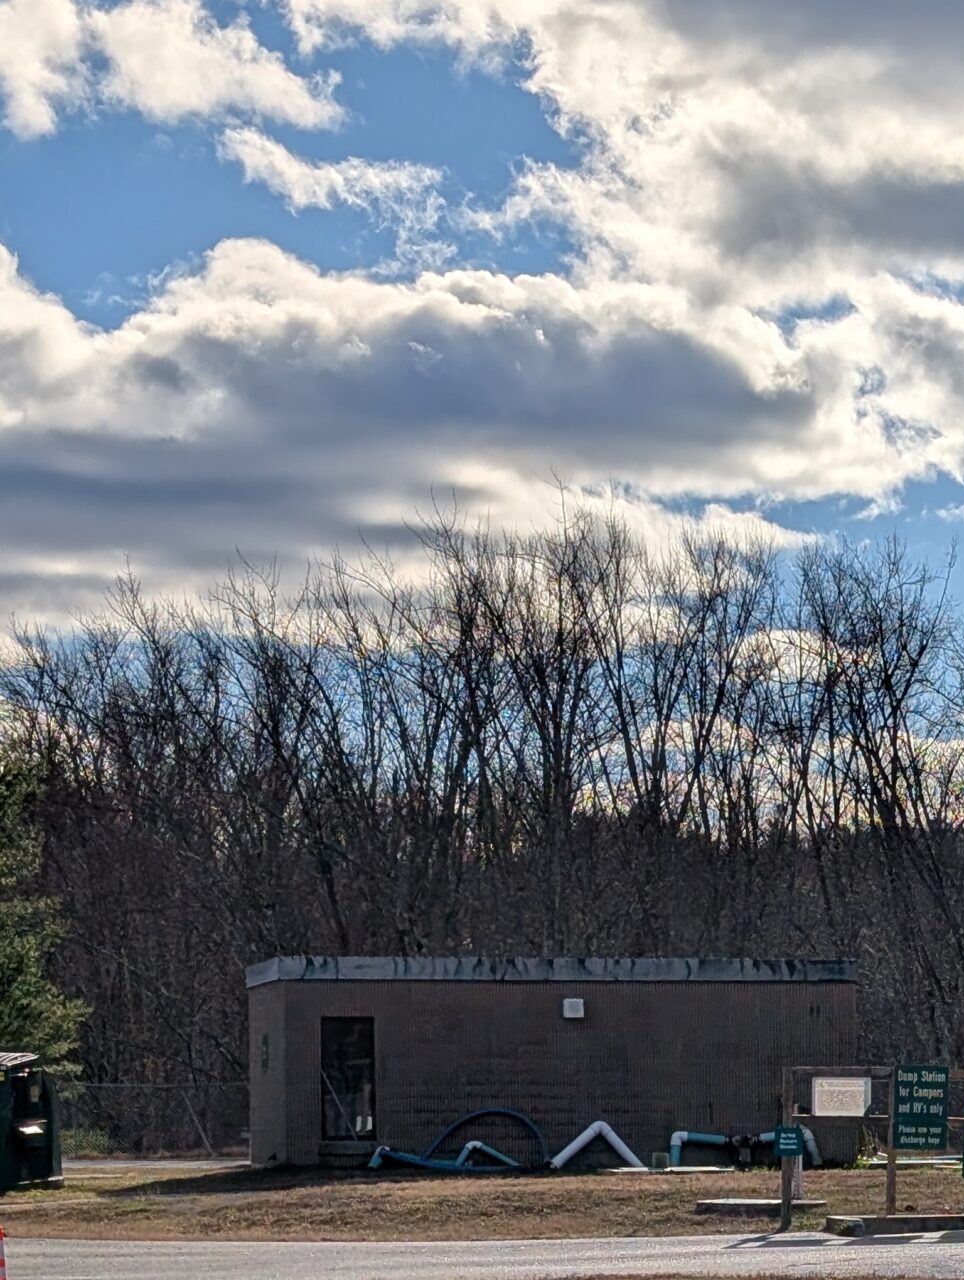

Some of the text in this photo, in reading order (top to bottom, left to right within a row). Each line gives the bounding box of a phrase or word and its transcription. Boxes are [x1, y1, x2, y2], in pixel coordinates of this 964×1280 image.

[898, 1069, 946, 1083] Dump Station
[899, 1086, 944, 1100] for Campers
[898, 1102, 943, 1116] and RV's only
[898, 1124, 916, 1134] Please
[929, 1127, 942, 1135] your
[900, 1135, 926, 1146] discharge
